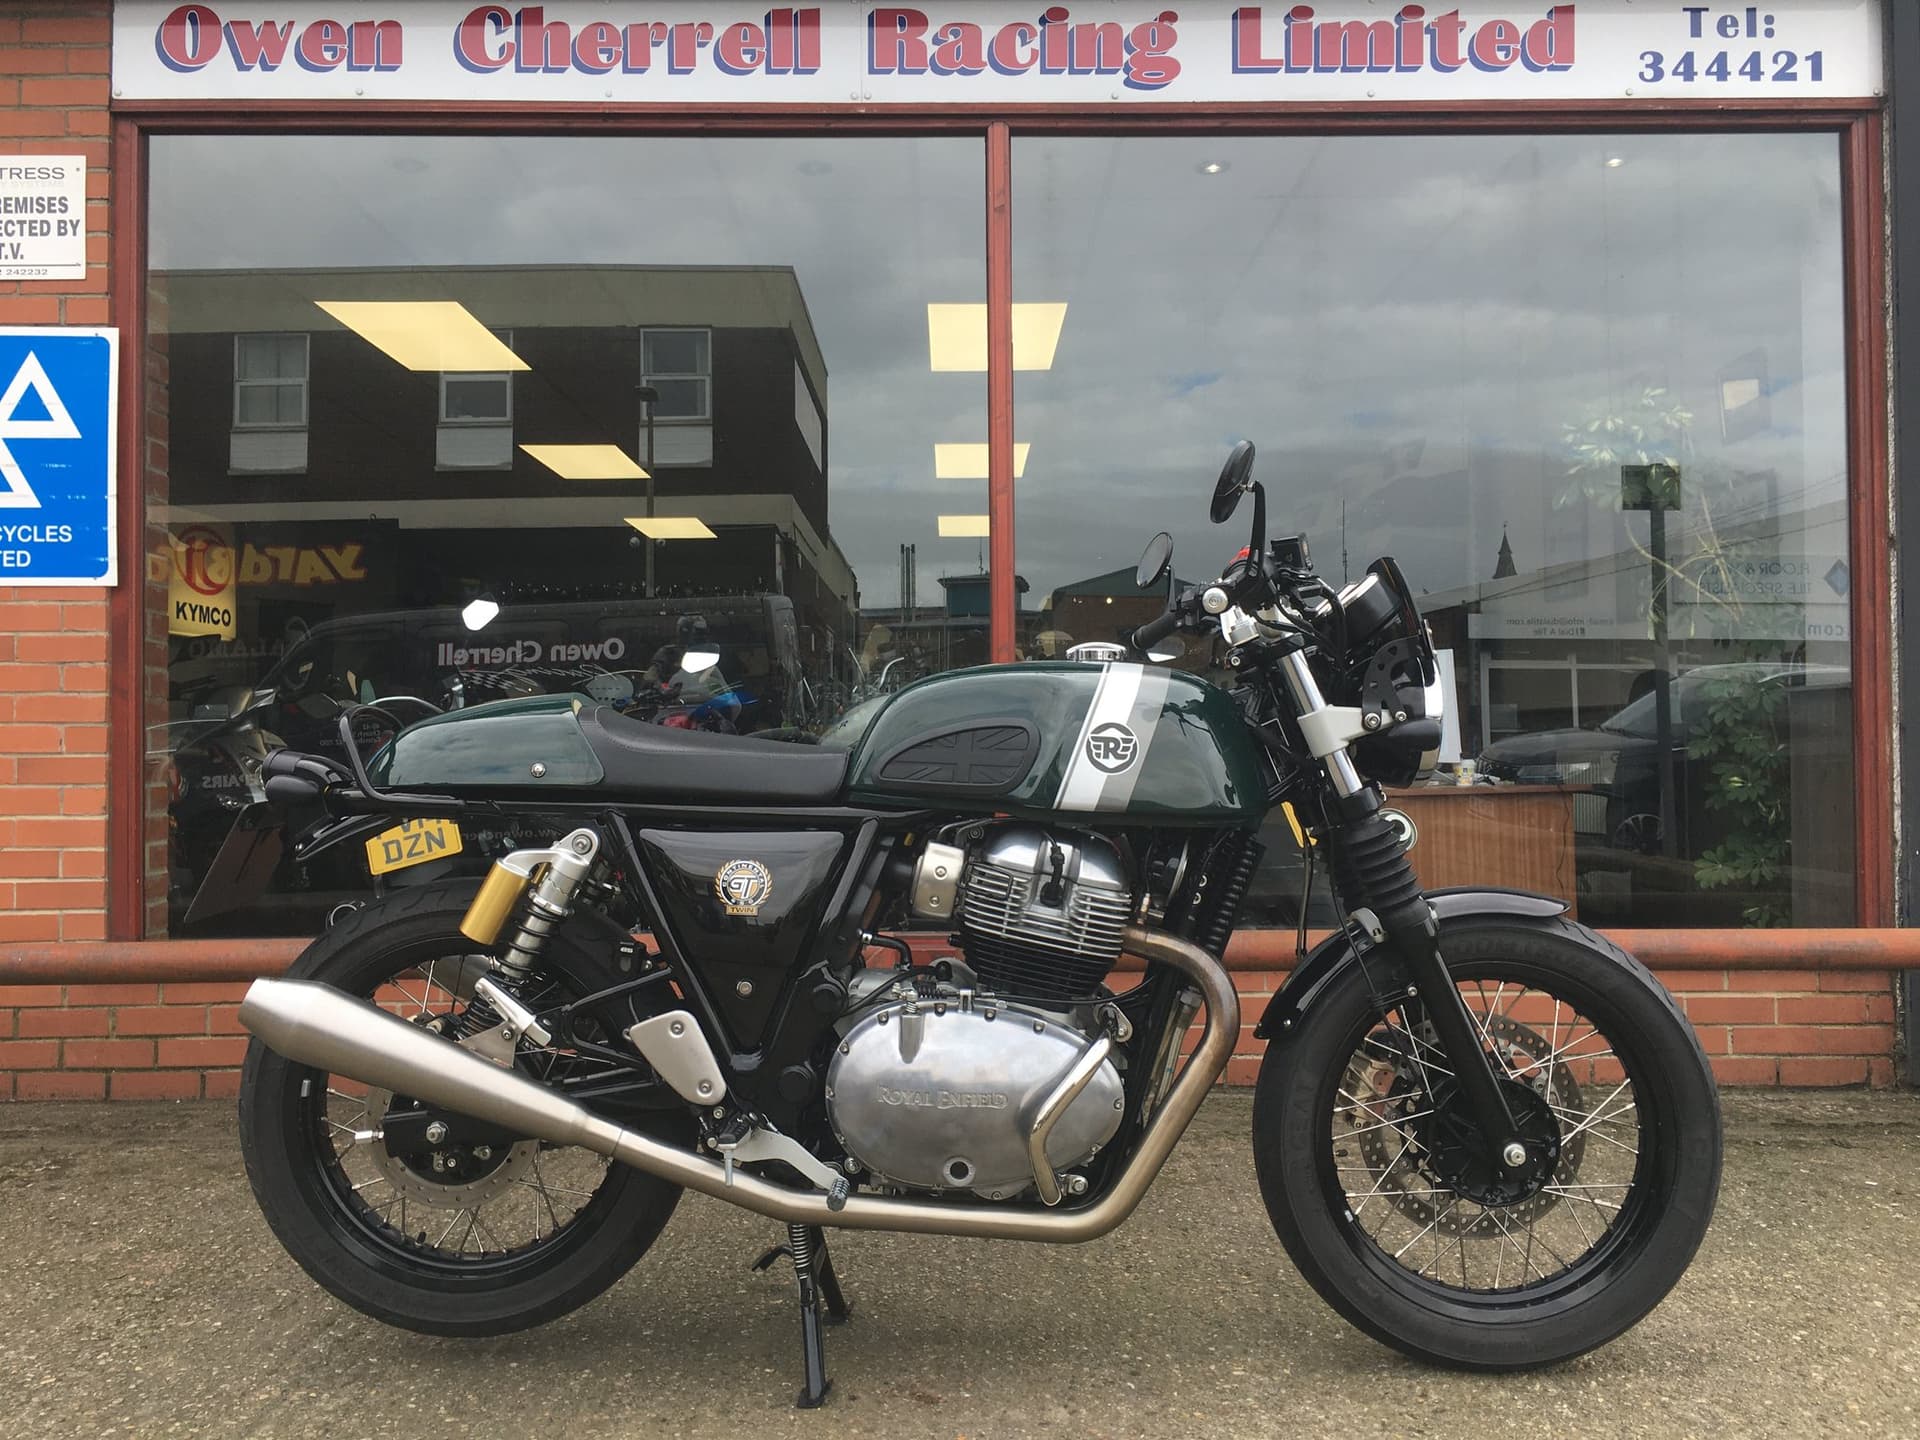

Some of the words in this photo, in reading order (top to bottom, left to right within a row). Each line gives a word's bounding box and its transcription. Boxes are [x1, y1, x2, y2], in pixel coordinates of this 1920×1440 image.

[1682, 7, 1775, 38] Tel:
[155, 4, 403, 73] Owen
[453, 6, 820, 75] Cherrell
[868, 7, 1182, 91] Racing
[1232, 4, 1575, 74] Limited
[1638, 50, 1823, 82] 344421
[0, 197, 69, 214] EMISES
[57, 220, 80, 237] BY
[0, 525, 73, 543] YCLES
[0, 550, 31, 568] ED
[175, 600, 232, 627] KYMCO
[382, 827, 446, 864] DZN
[729, 875, 758, 899] GT
[877, 1083, 935, 1107] ROYAL
[936, 1088, 1009, 1110] ENFIELD
